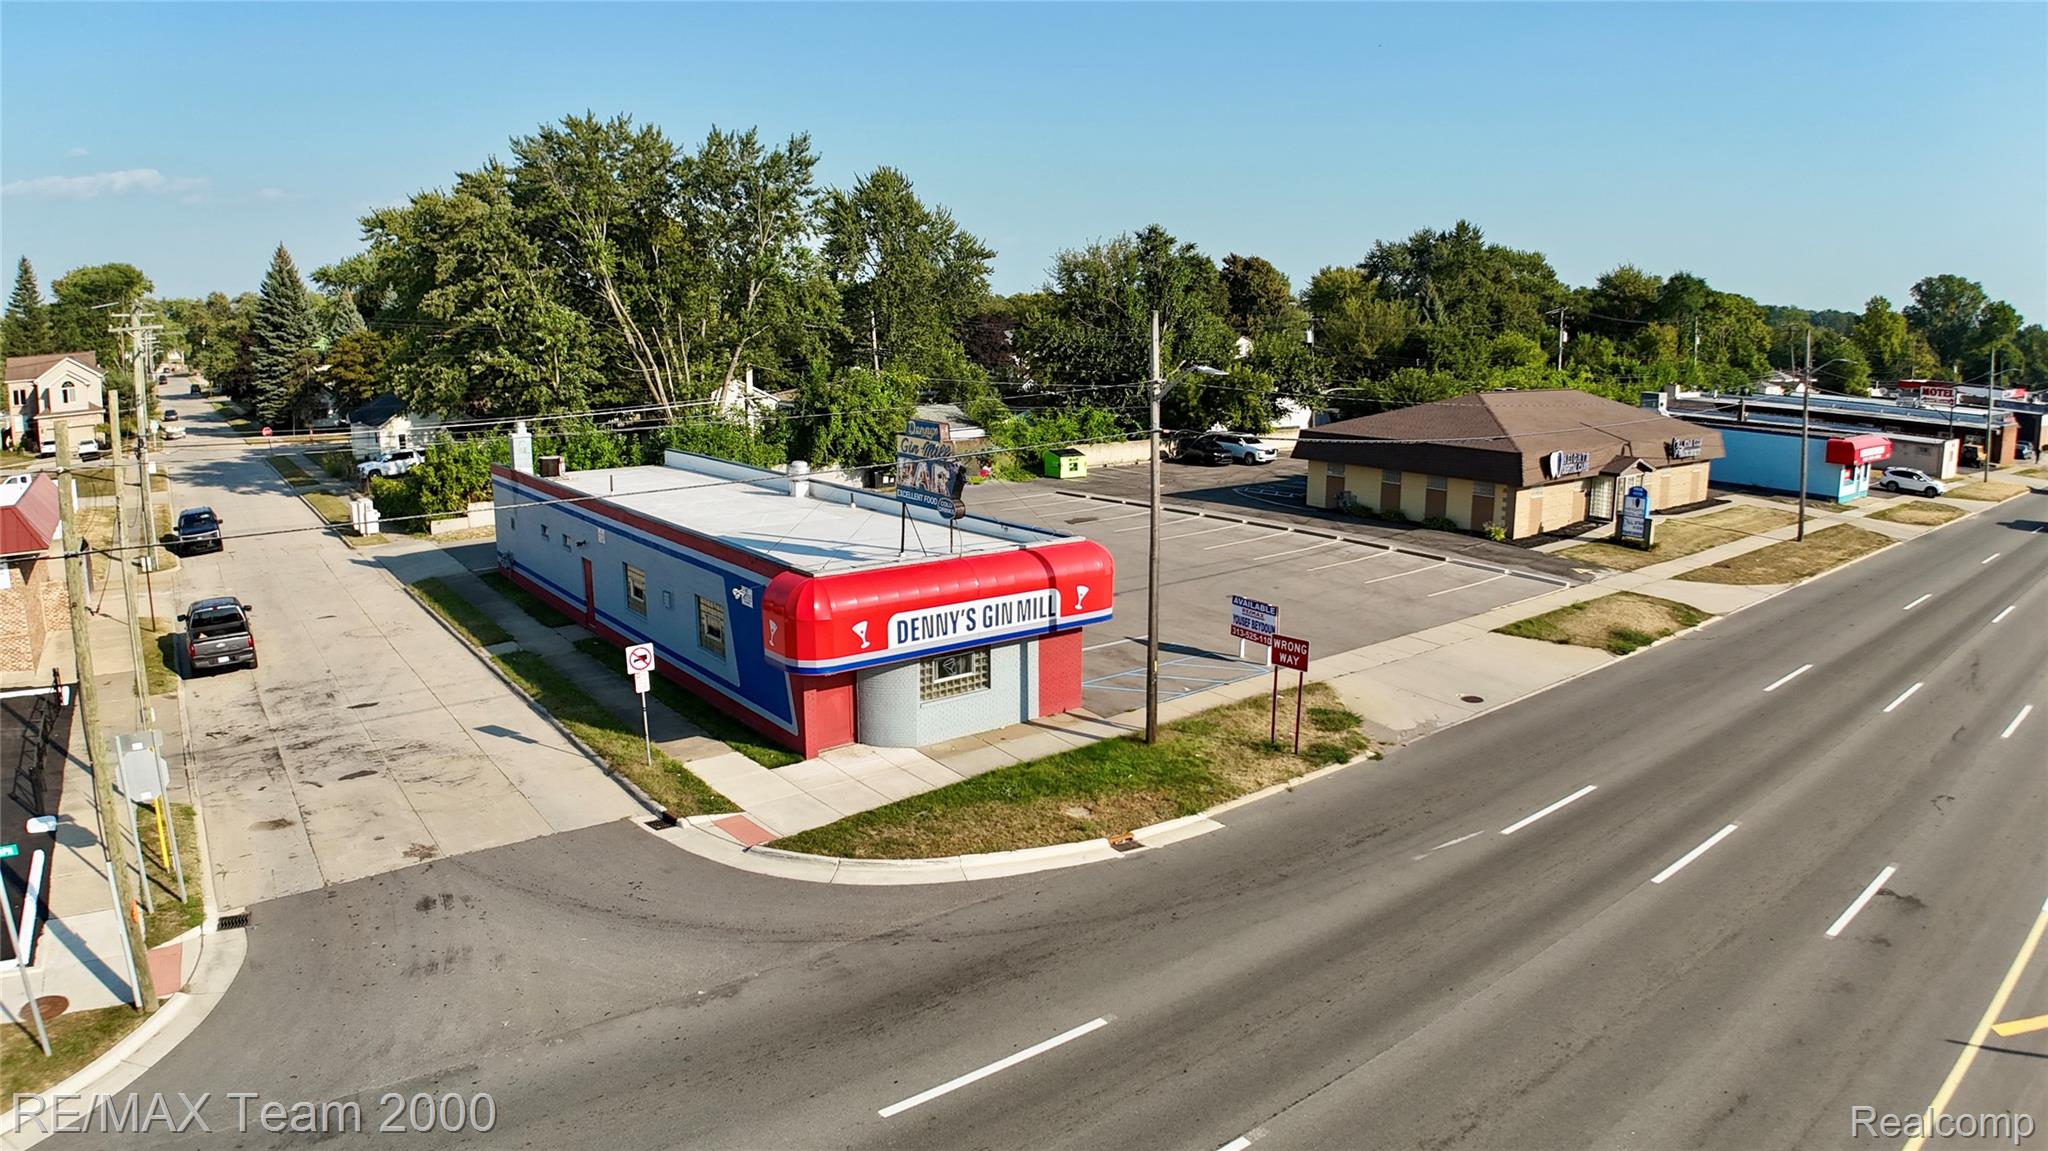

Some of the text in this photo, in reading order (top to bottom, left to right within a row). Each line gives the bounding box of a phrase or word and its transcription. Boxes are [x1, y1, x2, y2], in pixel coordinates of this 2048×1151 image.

[1922, 387, 1955, 398] MOTEL
[901, 437, 919, 455] Gin
[897, 489, 938, 505] EXCELLENT FOOD
[1234, 597, 1275, 614] AVAILABLE
[1242, 608, 1264, 618] RE/MAX
[897, 595, 1056, 644] DENNY'S GIN MILL
[1233, 614, 1275, 634] YOUSEF BEYDOUN
[1232, 627, 1272, 645] 313-525-110
[1273, 638, 1307, 655] WRONG
[1280, 652, 1300, 666] WAY
